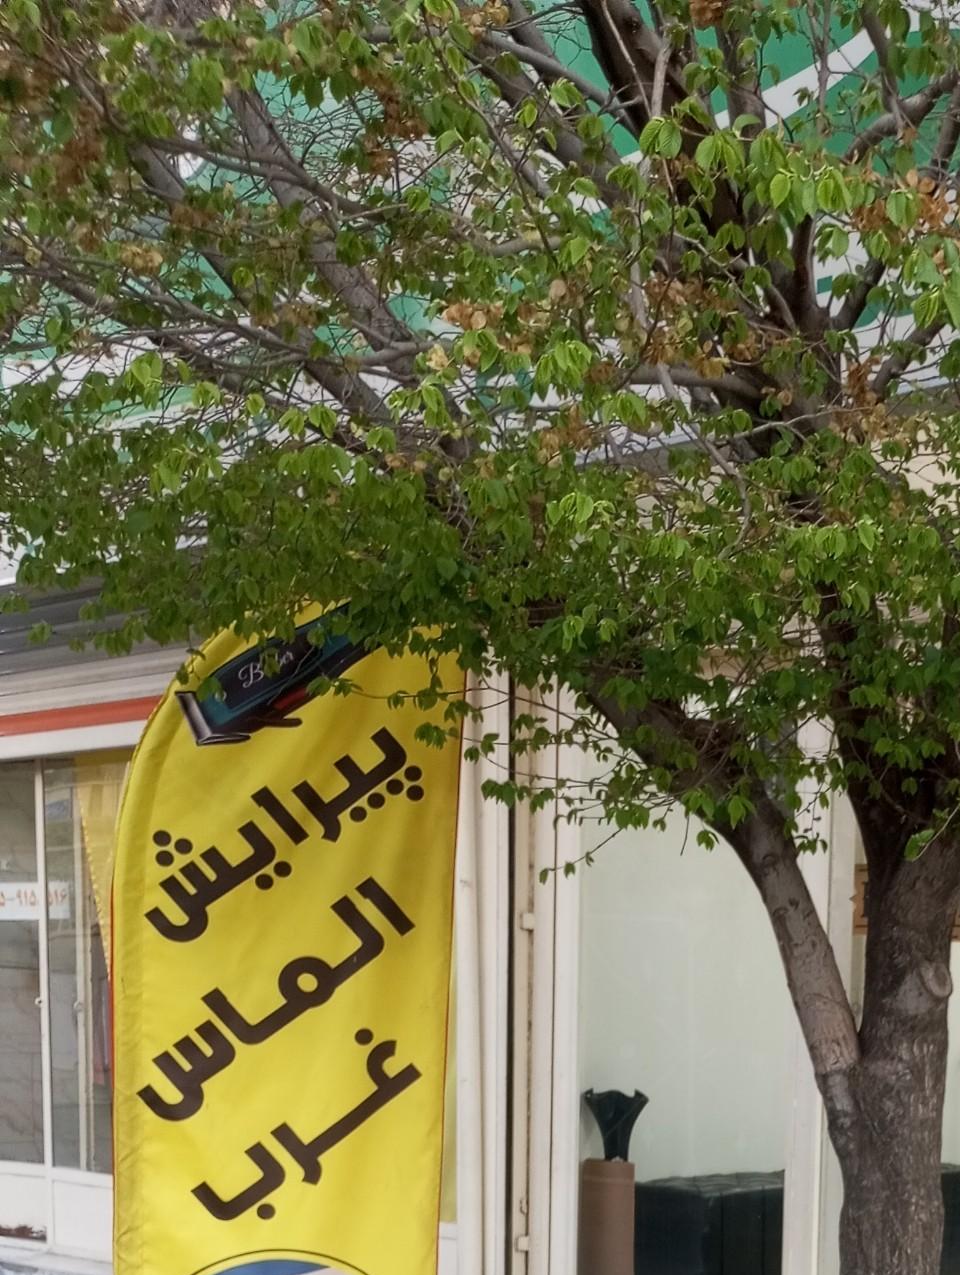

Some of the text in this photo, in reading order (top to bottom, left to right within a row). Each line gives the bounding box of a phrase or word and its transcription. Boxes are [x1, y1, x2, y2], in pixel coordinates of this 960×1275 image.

[145, 727, 424, 942] پیرایش
[137, 877, 415, 1122] الماس
[191, 1029, 421, 1221] غرب
